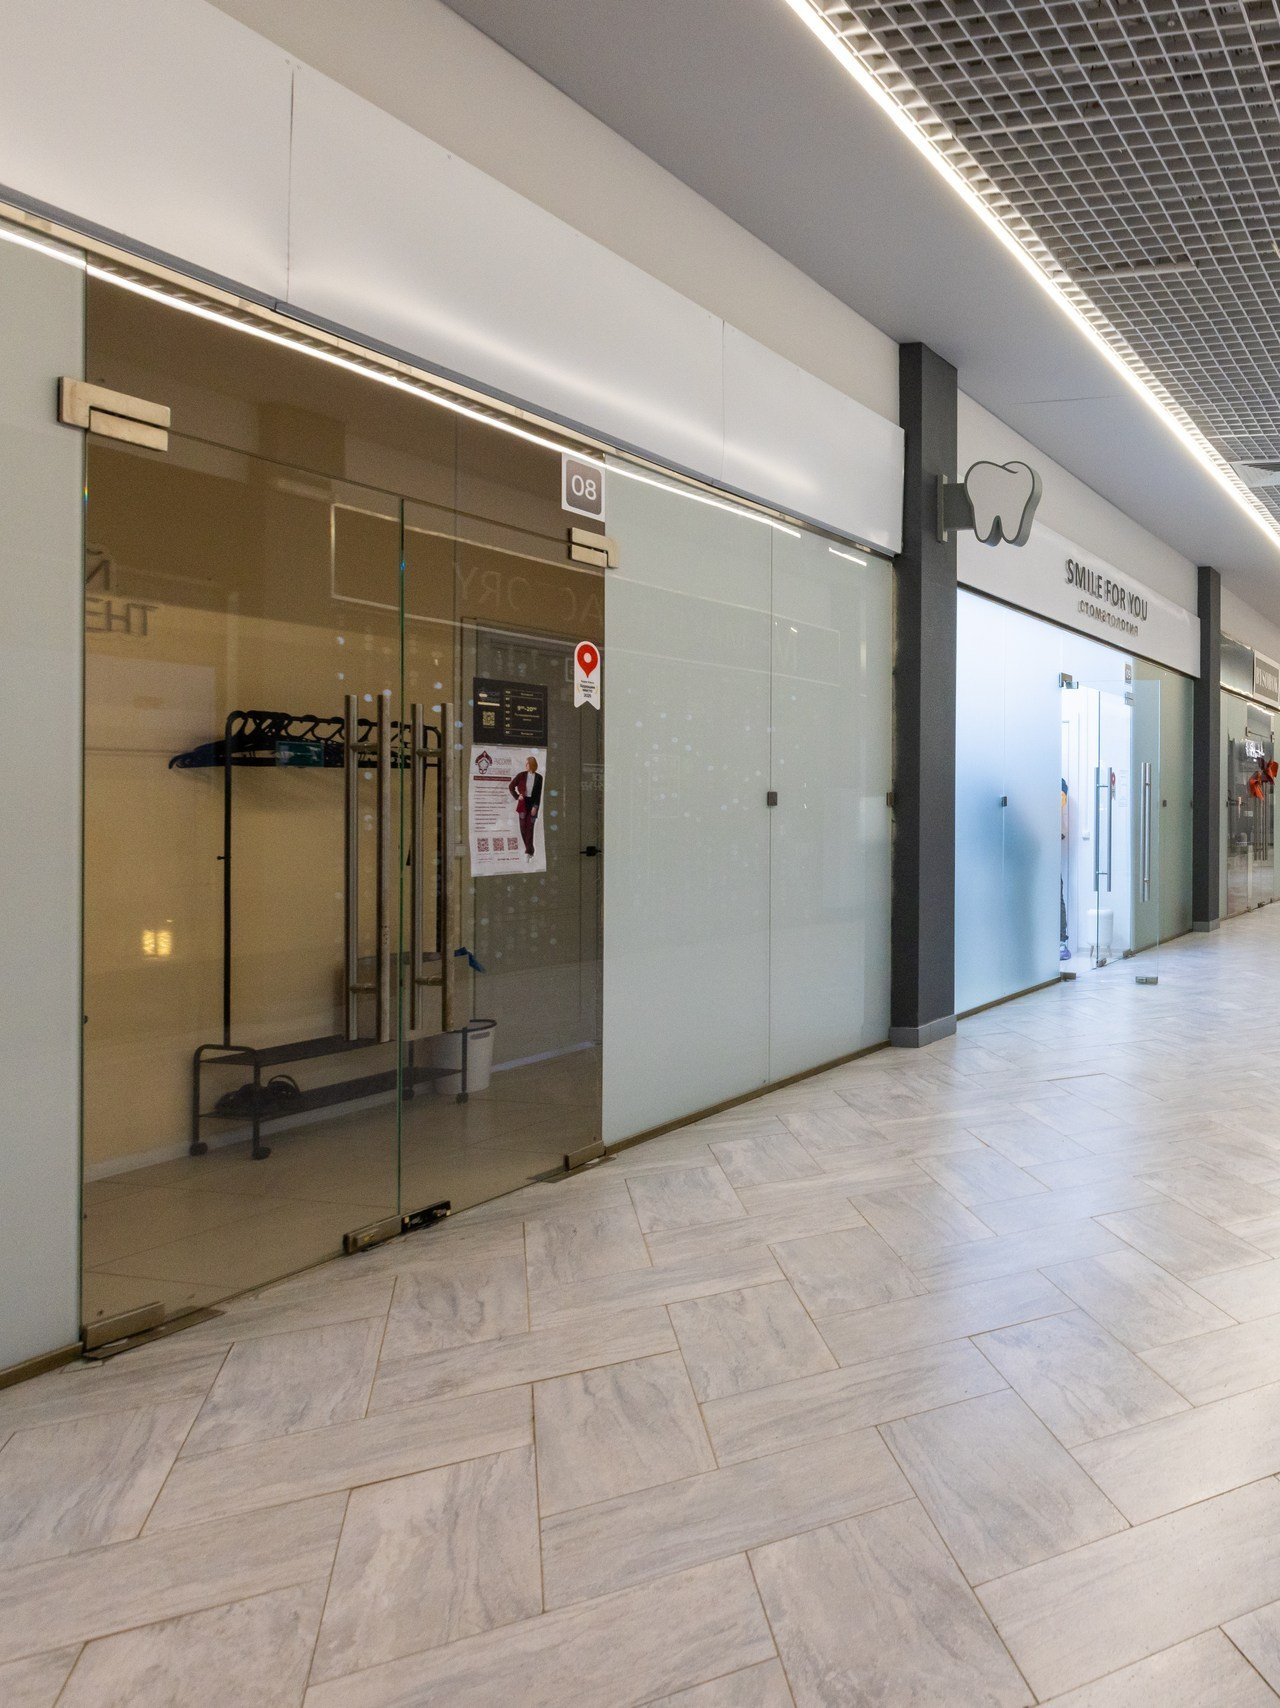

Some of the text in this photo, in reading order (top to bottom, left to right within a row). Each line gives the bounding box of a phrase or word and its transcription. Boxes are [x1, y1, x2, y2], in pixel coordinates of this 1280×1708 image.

[571, 474, 597, 501] 08
[1067, 558, 1148, 621] SMILE FOR YOU
